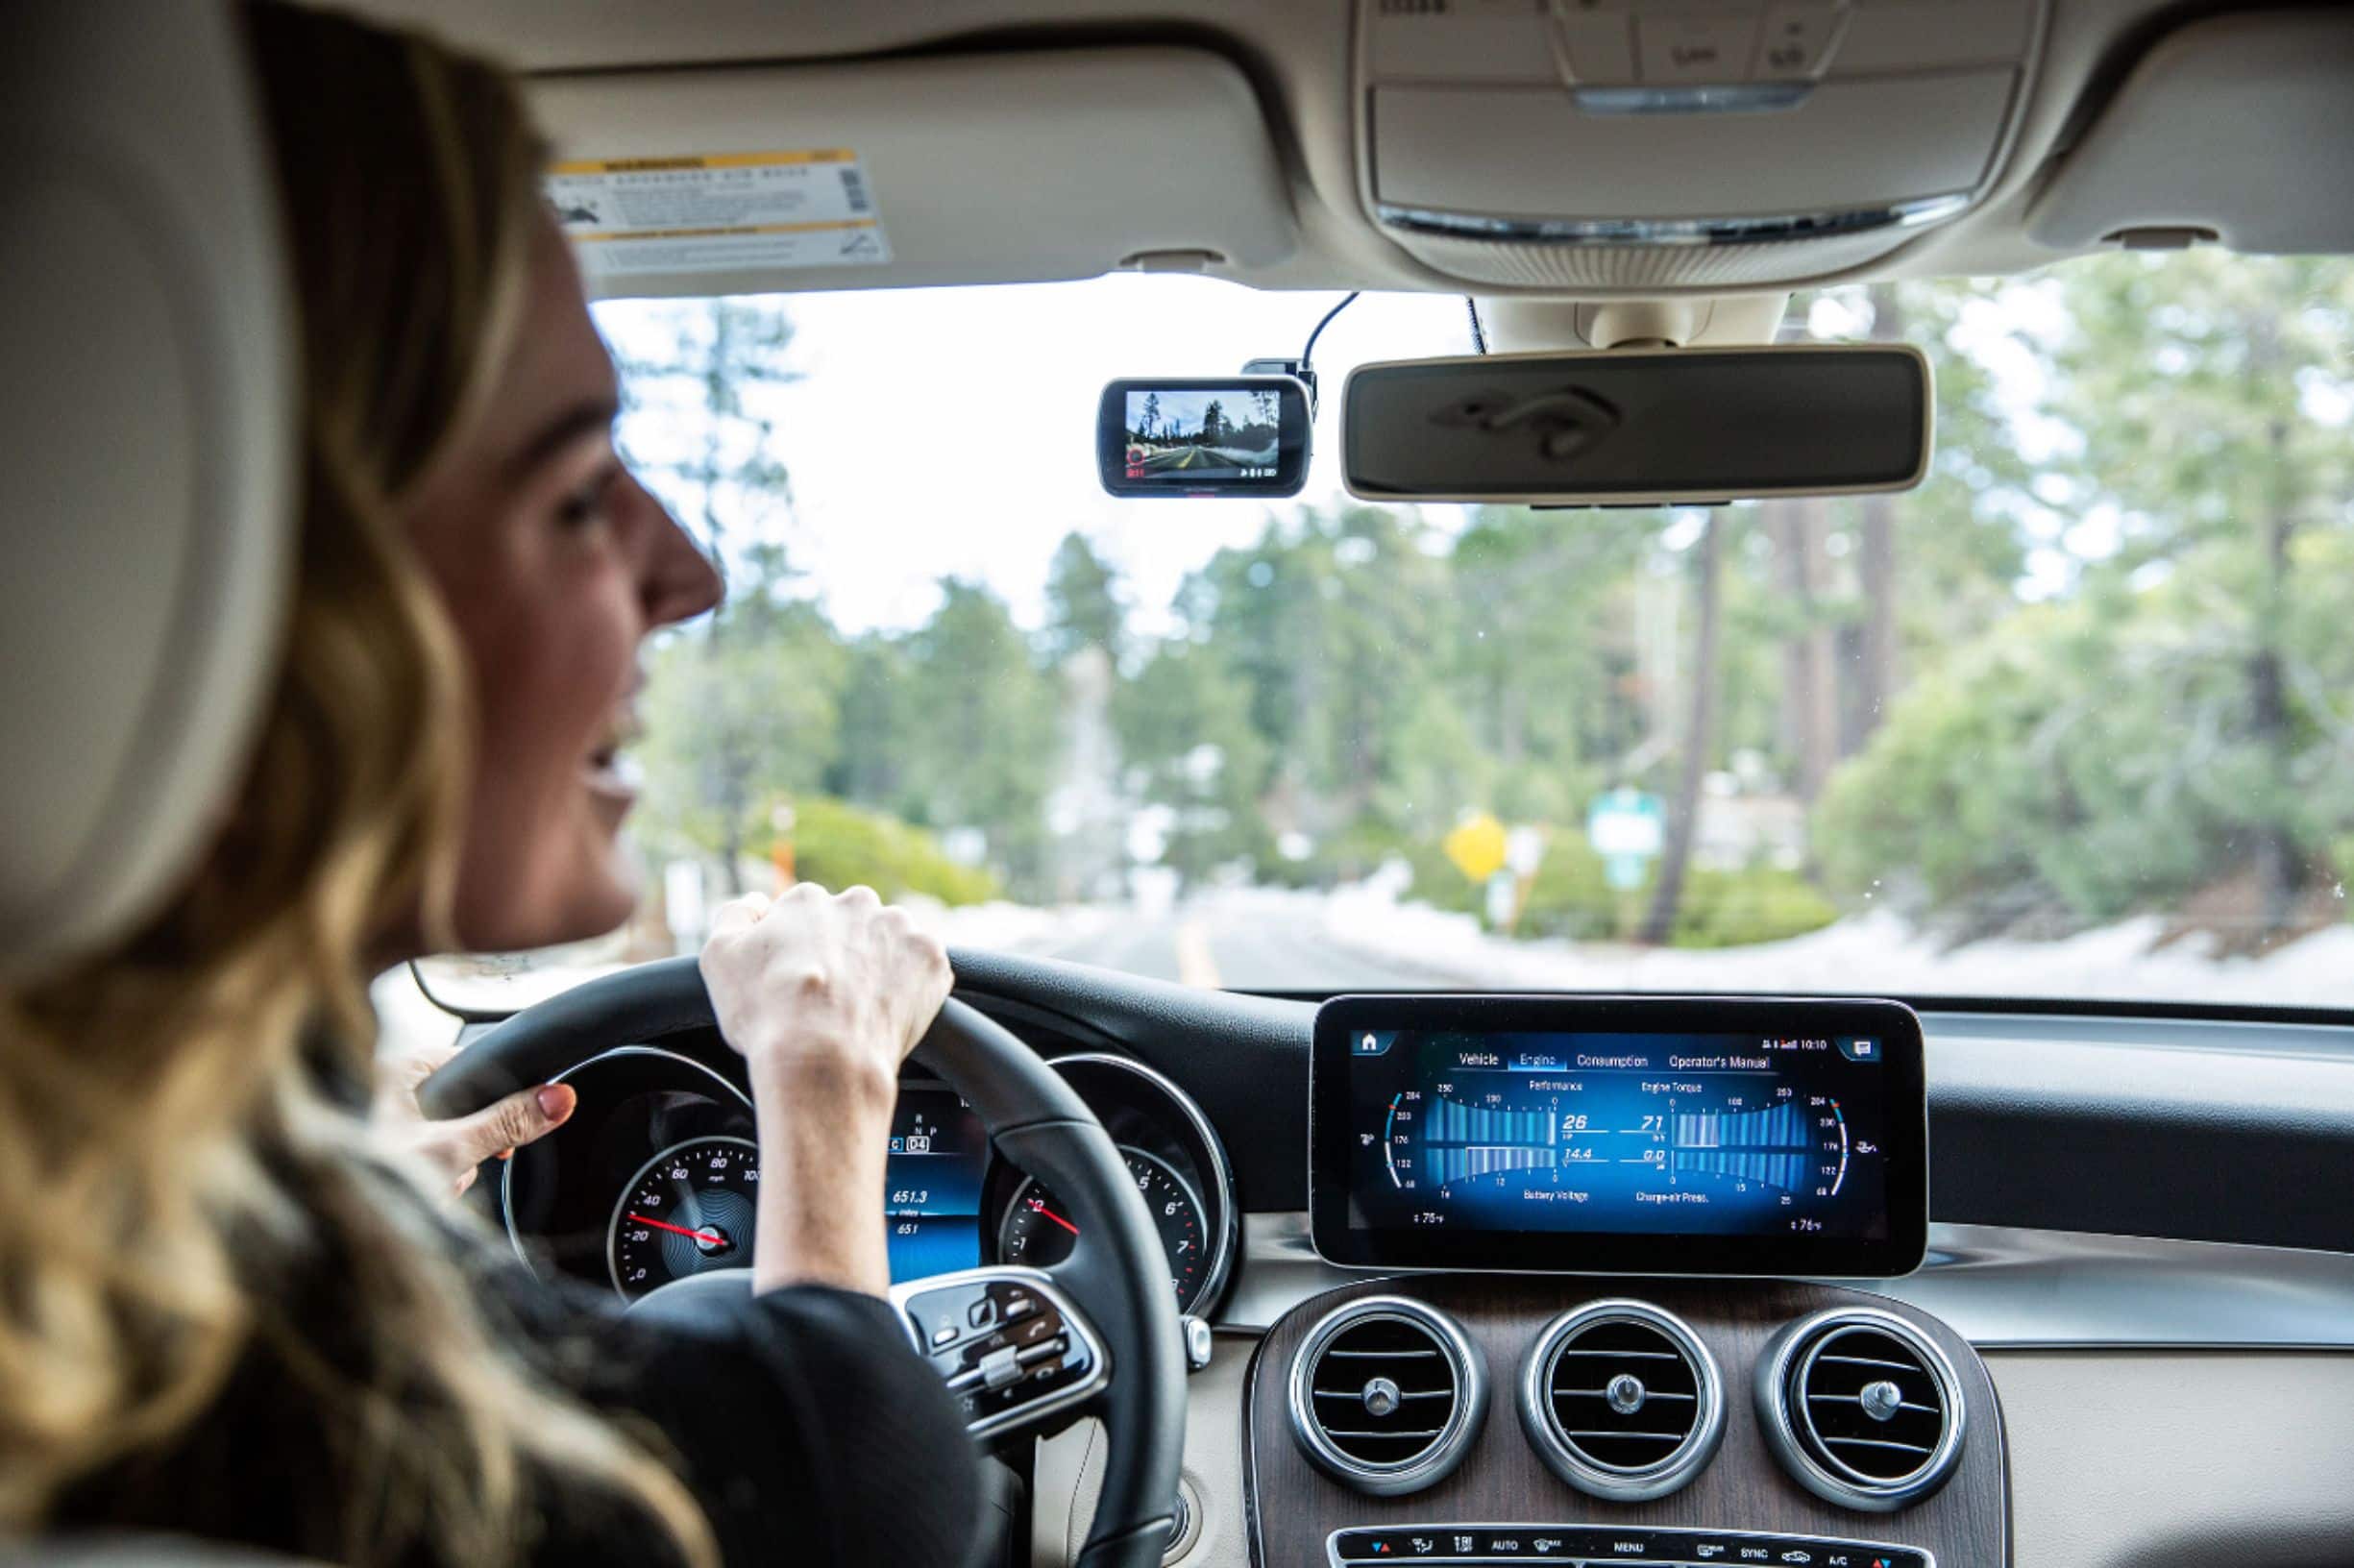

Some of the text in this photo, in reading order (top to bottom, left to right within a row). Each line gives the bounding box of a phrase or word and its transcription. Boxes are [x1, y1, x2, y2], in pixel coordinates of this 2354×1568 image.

[1802, 1040, 1827, 1050] 10:10
[1459, 1053, 1499, 1066] Vehicle
[1520, 1053, 1557, 1066] Engine
[1577, 1054, 1649, 1067] Consumption
[1669, 1055, 1770, 1069] Operator's Manual
[1529, 1080, 1583, 1091] Performance
[1641, 1081, 1703, 1094] Engine Torque
[1562, 1115, 1588, 1130] 26
[1641, 1115, 1663, 1131] 71
[910, 1139, 926, 1149] D4
[1565, 1148, 1592, 1160] 14.4
[711, 1158, 727, 1168] 80
[673, 1168, 689, 1180] 60
[1138, 1176, 1150, 1190] 5
[643, 1194, 661, 1206] 40
[892, 1190, 929, 1204] 651.3
[1523, 1190, 1589, 1203] Battery Voltage
[1682, 1192, 1710, 1204] Press.
[1165, 1202, 1177, 1216] 6
[896, 1223, 920, 1236] 651
[631, 1231, 650, 1242] 20
[1176, 1240, 1189, 1255] 7
[636, 1269, 647, 1280] 0
[1490, 1540, 1519, 1551] AUTO
[1614, 1541, 1644, 1554] MENU
[1740, 1547, 1769, 1559] SYNC
[1829, 1556, 1848, 1566] A/C
